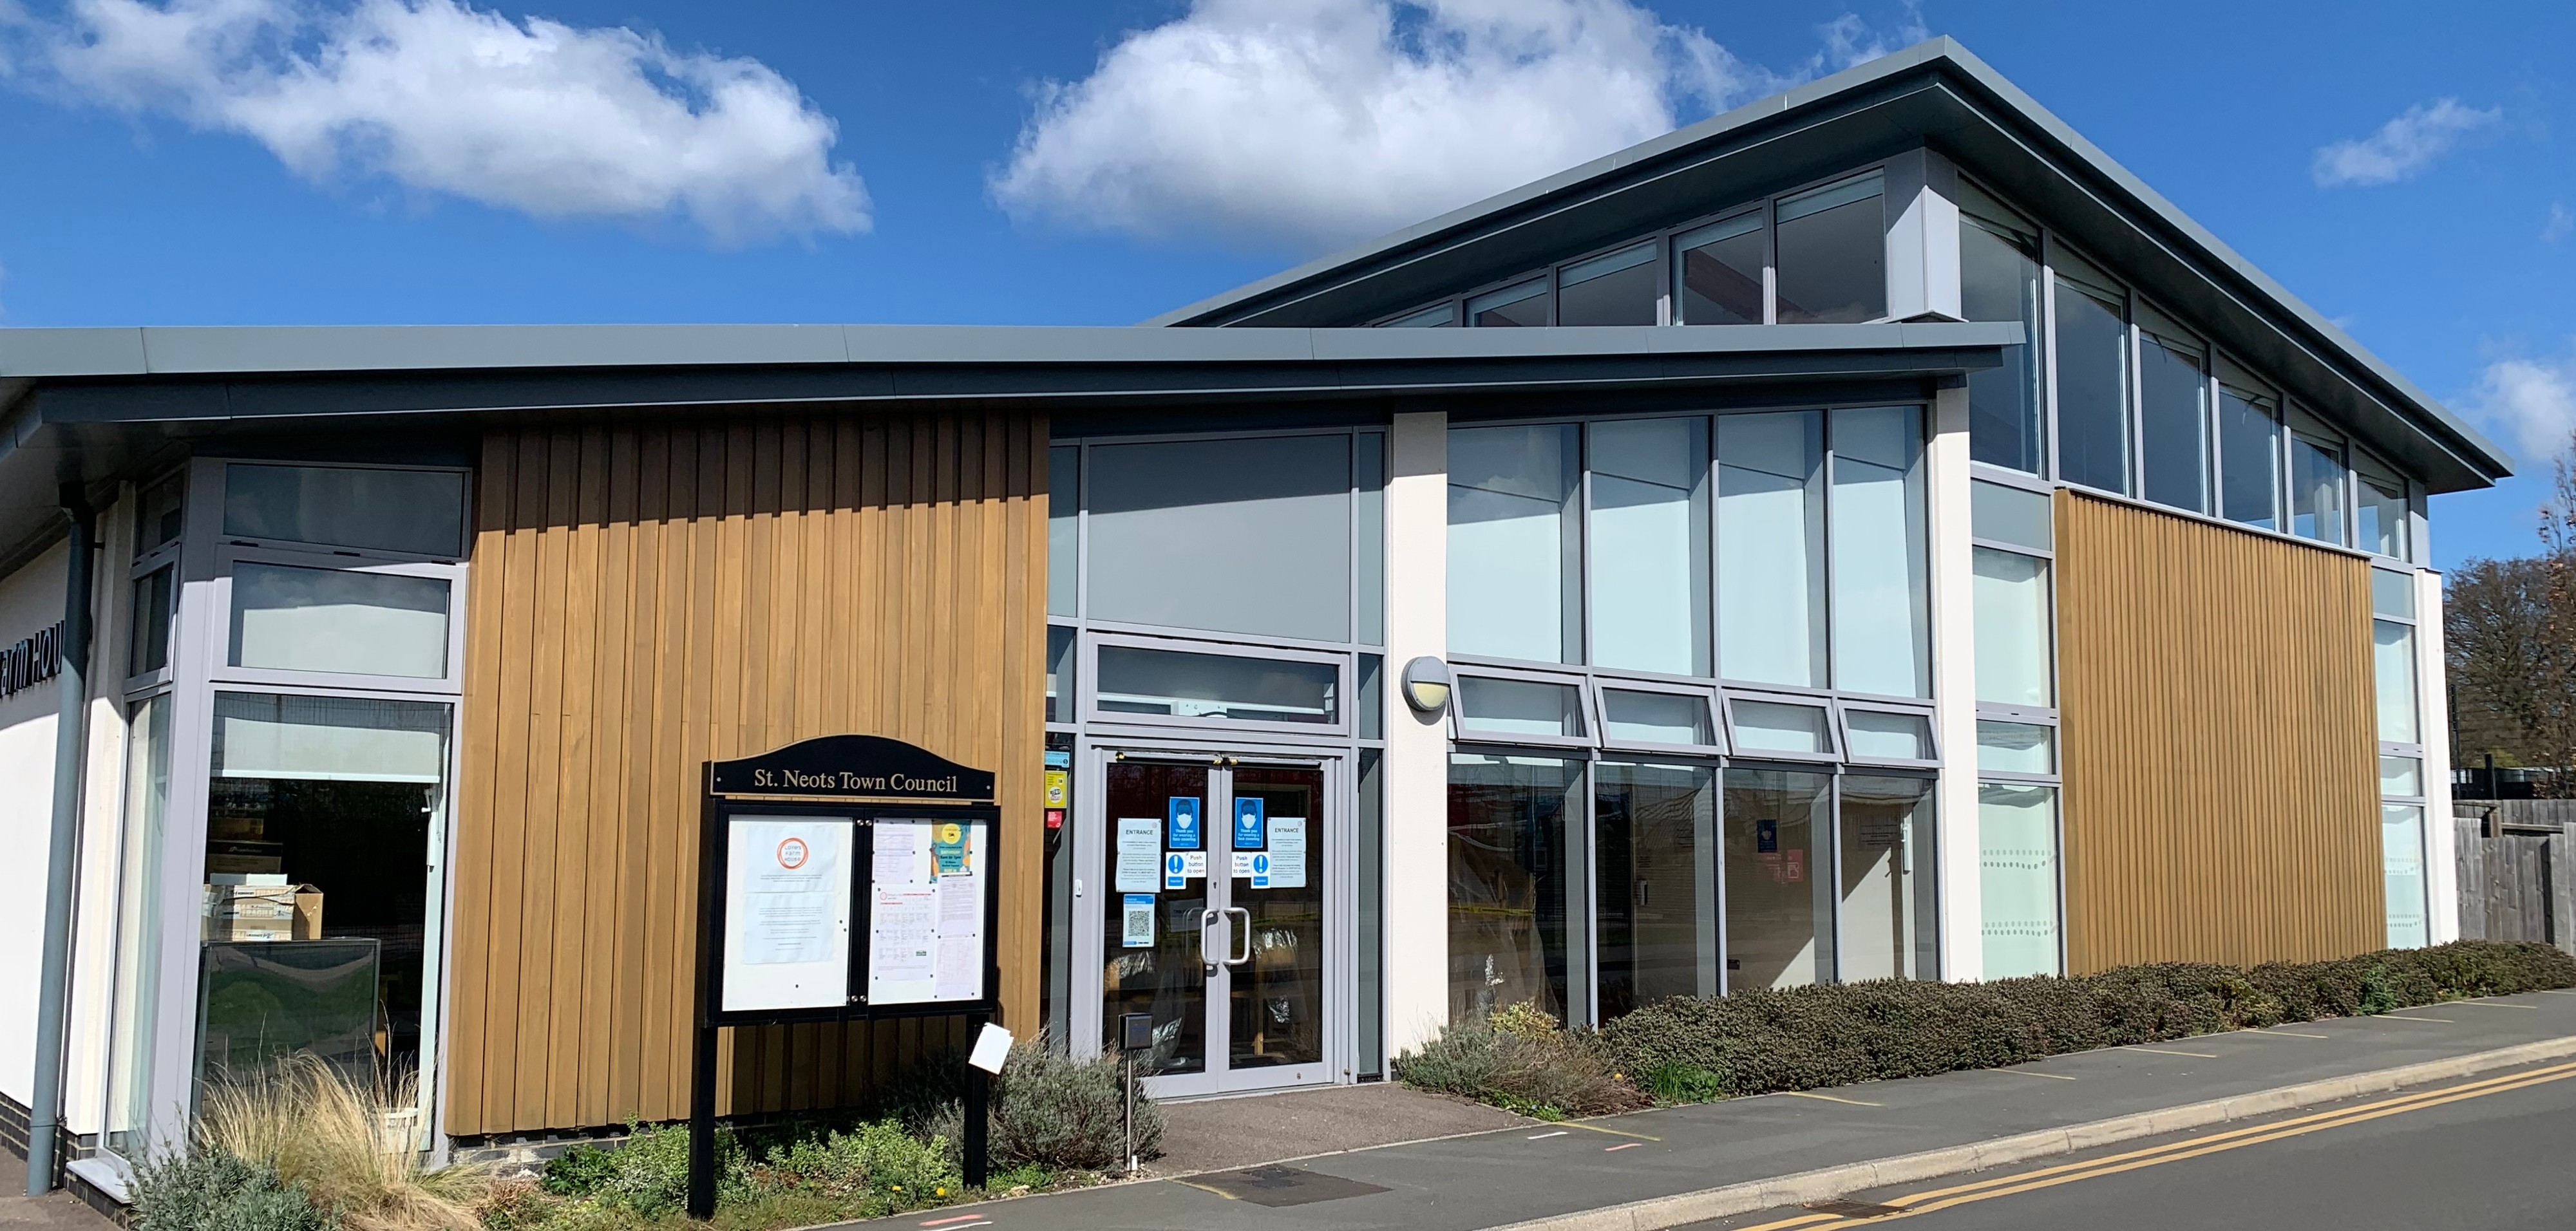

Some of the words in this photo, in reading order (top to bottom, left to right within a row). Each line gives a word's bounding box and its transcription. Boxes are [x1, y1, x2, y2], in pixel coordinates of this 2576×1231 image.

[755, 769, 778, 787] St.
[782, 770, 835, 789] Neots
[839, 772, 886, 790] Town
[890, 773, 957, 792] Council
